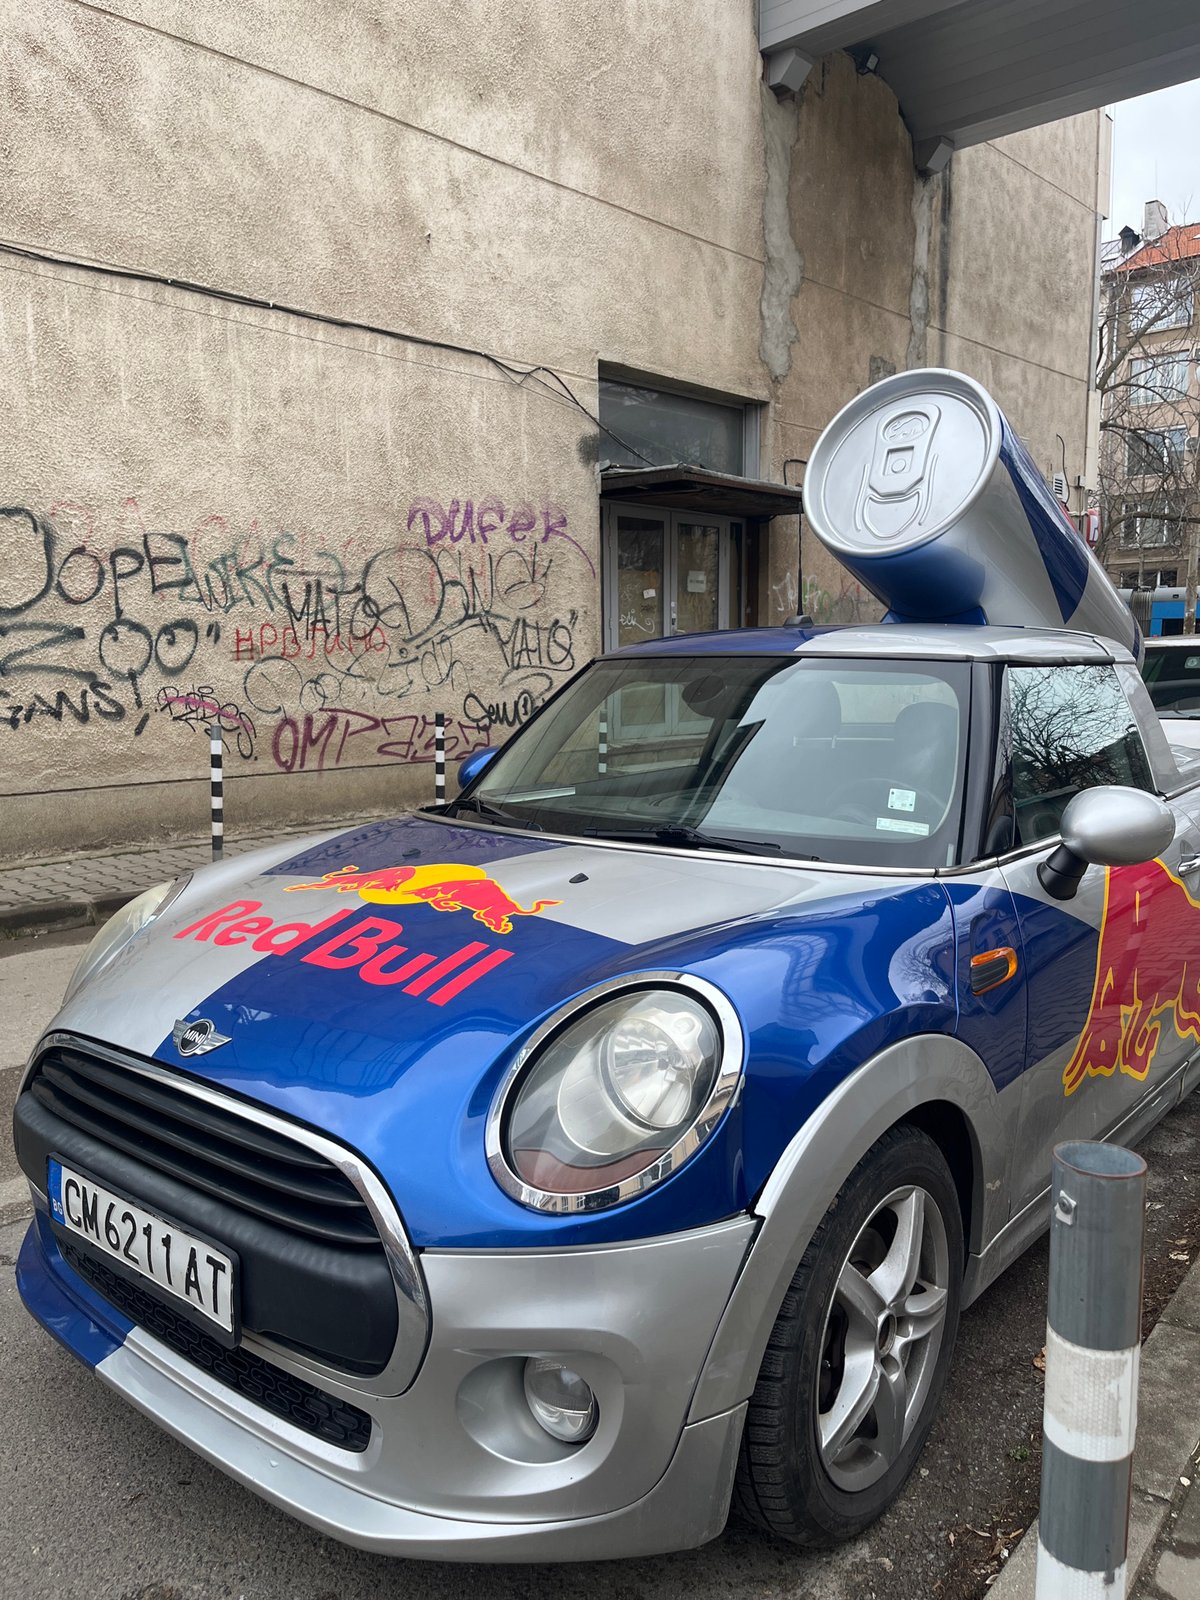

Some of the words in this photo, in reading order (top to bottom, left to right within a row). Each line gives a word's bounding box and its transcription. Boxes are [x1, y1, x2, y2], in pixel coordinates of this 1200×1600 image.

[172, 899, 356, 957] Red
[299, 915, 516, 1007] Bull
[183, 1028, 206, 1044] MINI
[52, 1198, 63, 1216] BG
